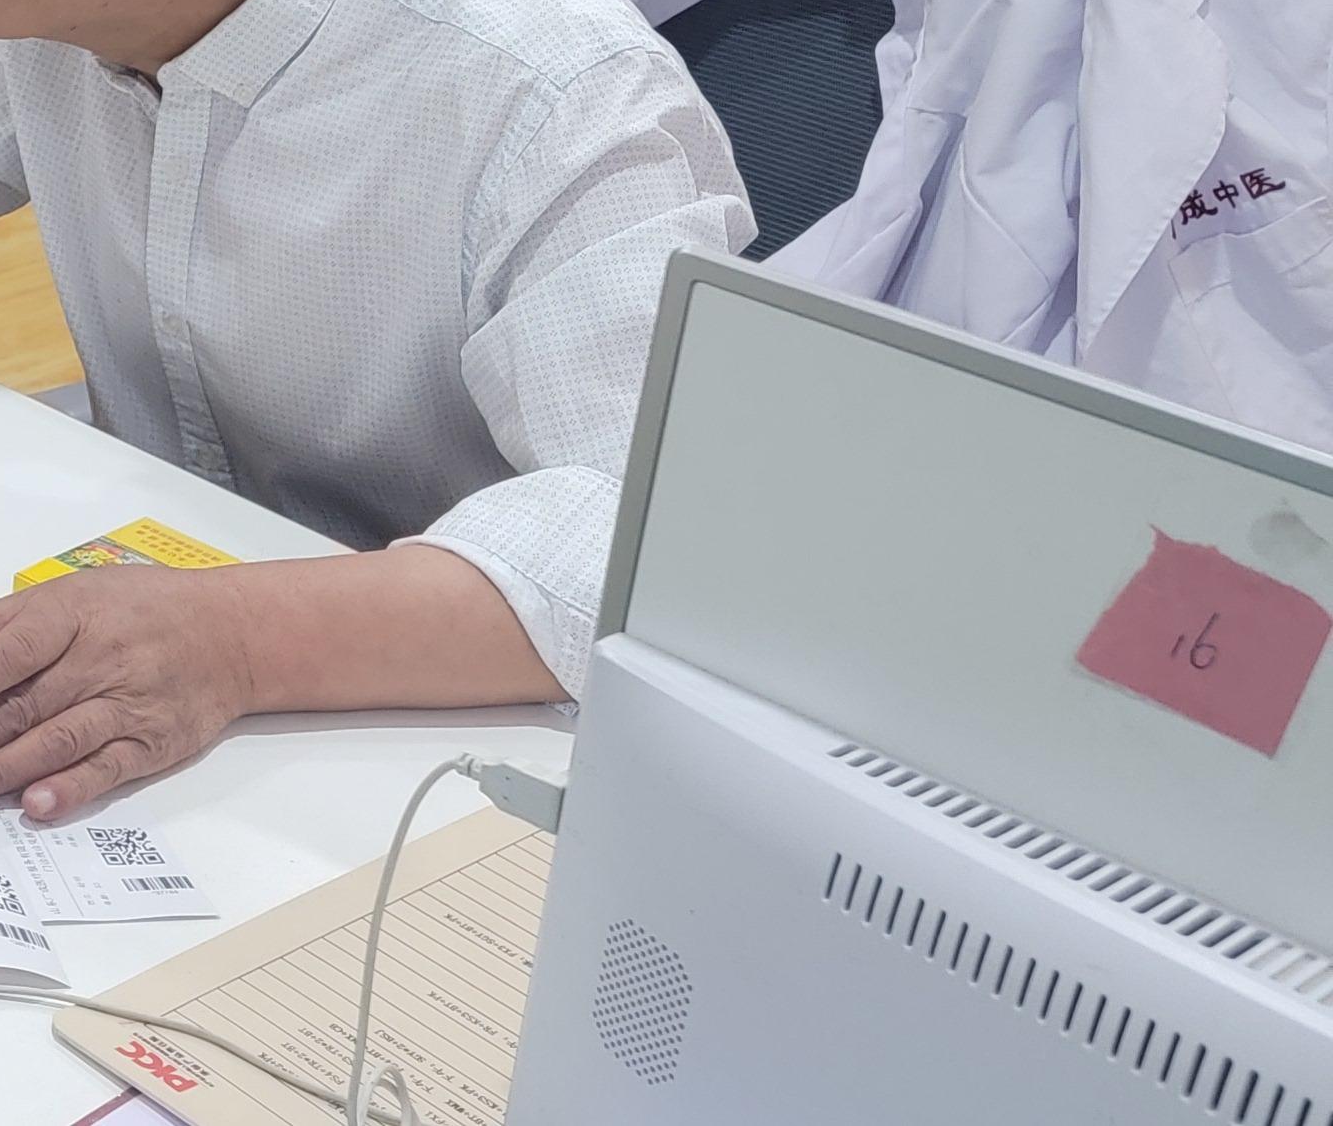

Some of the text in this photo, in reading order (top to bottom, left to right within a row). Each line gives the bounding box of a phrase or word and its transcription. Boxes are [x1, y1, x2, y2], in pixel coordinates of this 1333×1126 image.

[1170, 167, 1287, 241] 成中医
[1170, 612, 1221, 670] 16
[115, 1040, 199, 1092] PICC
